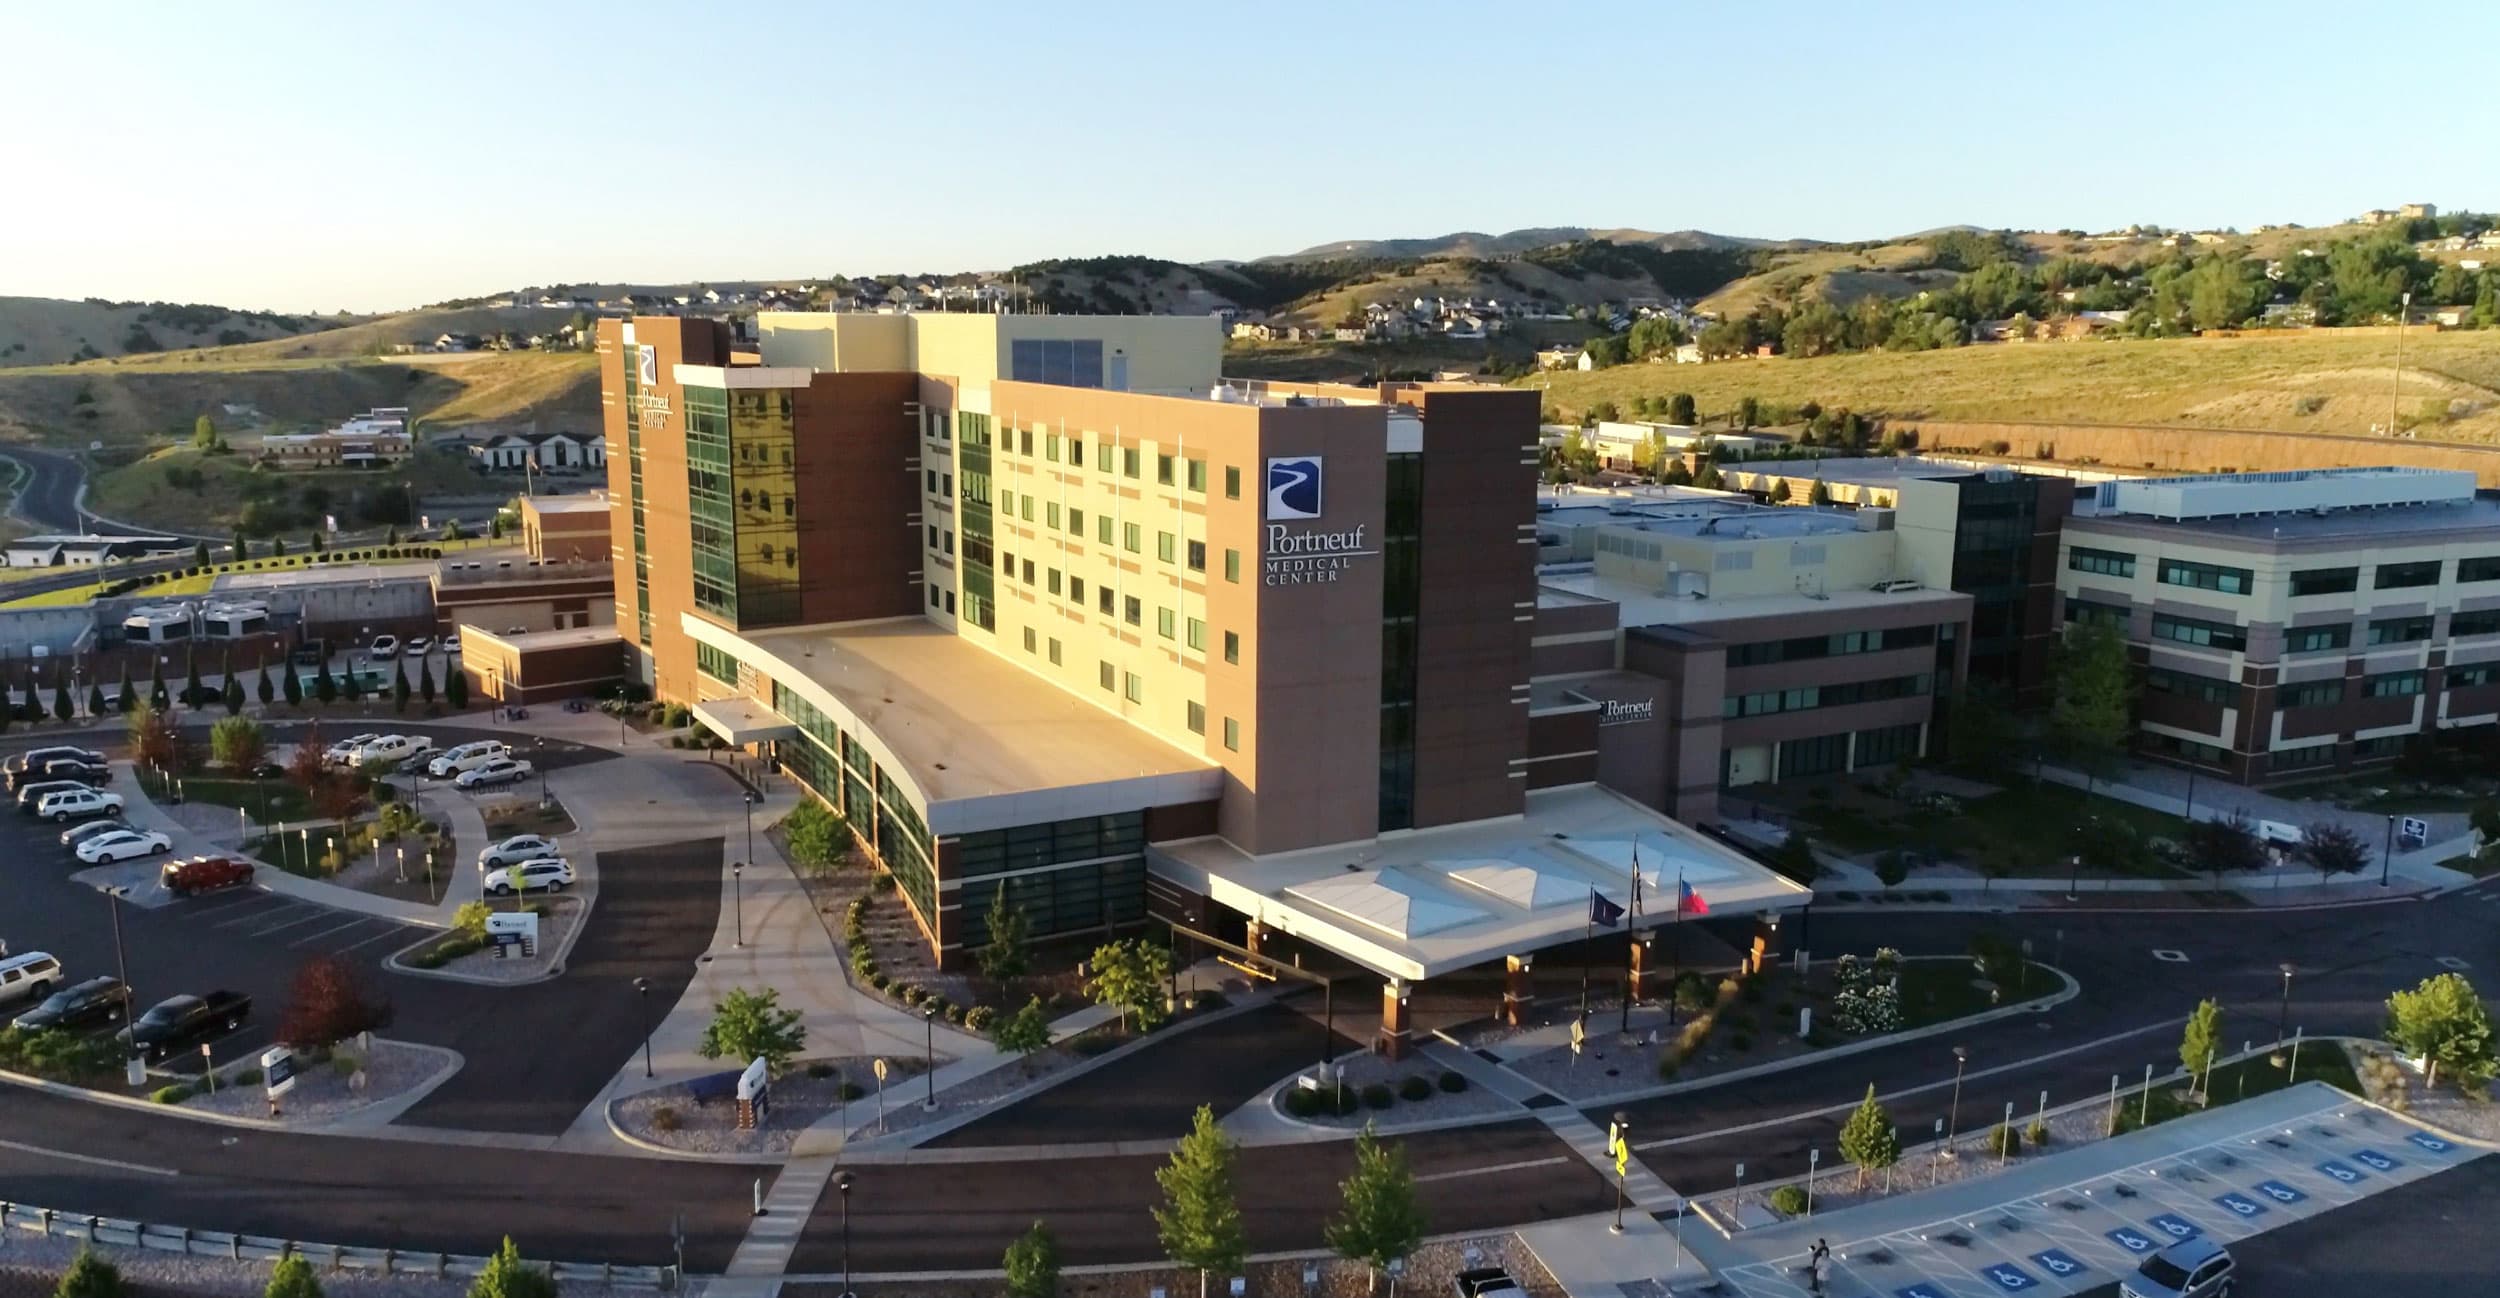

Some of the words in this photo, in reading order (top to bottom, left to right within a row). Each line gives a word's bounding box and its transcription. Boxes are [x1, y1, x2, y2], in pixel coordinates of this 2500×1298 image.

[1266, 524, 1365, 554] Portneuf
[1266, 558, 1350, 573] MEDICAL
[1266, 570, 1337, 586] CENTER
[1608, 697, 1653, 716] Portneuf
